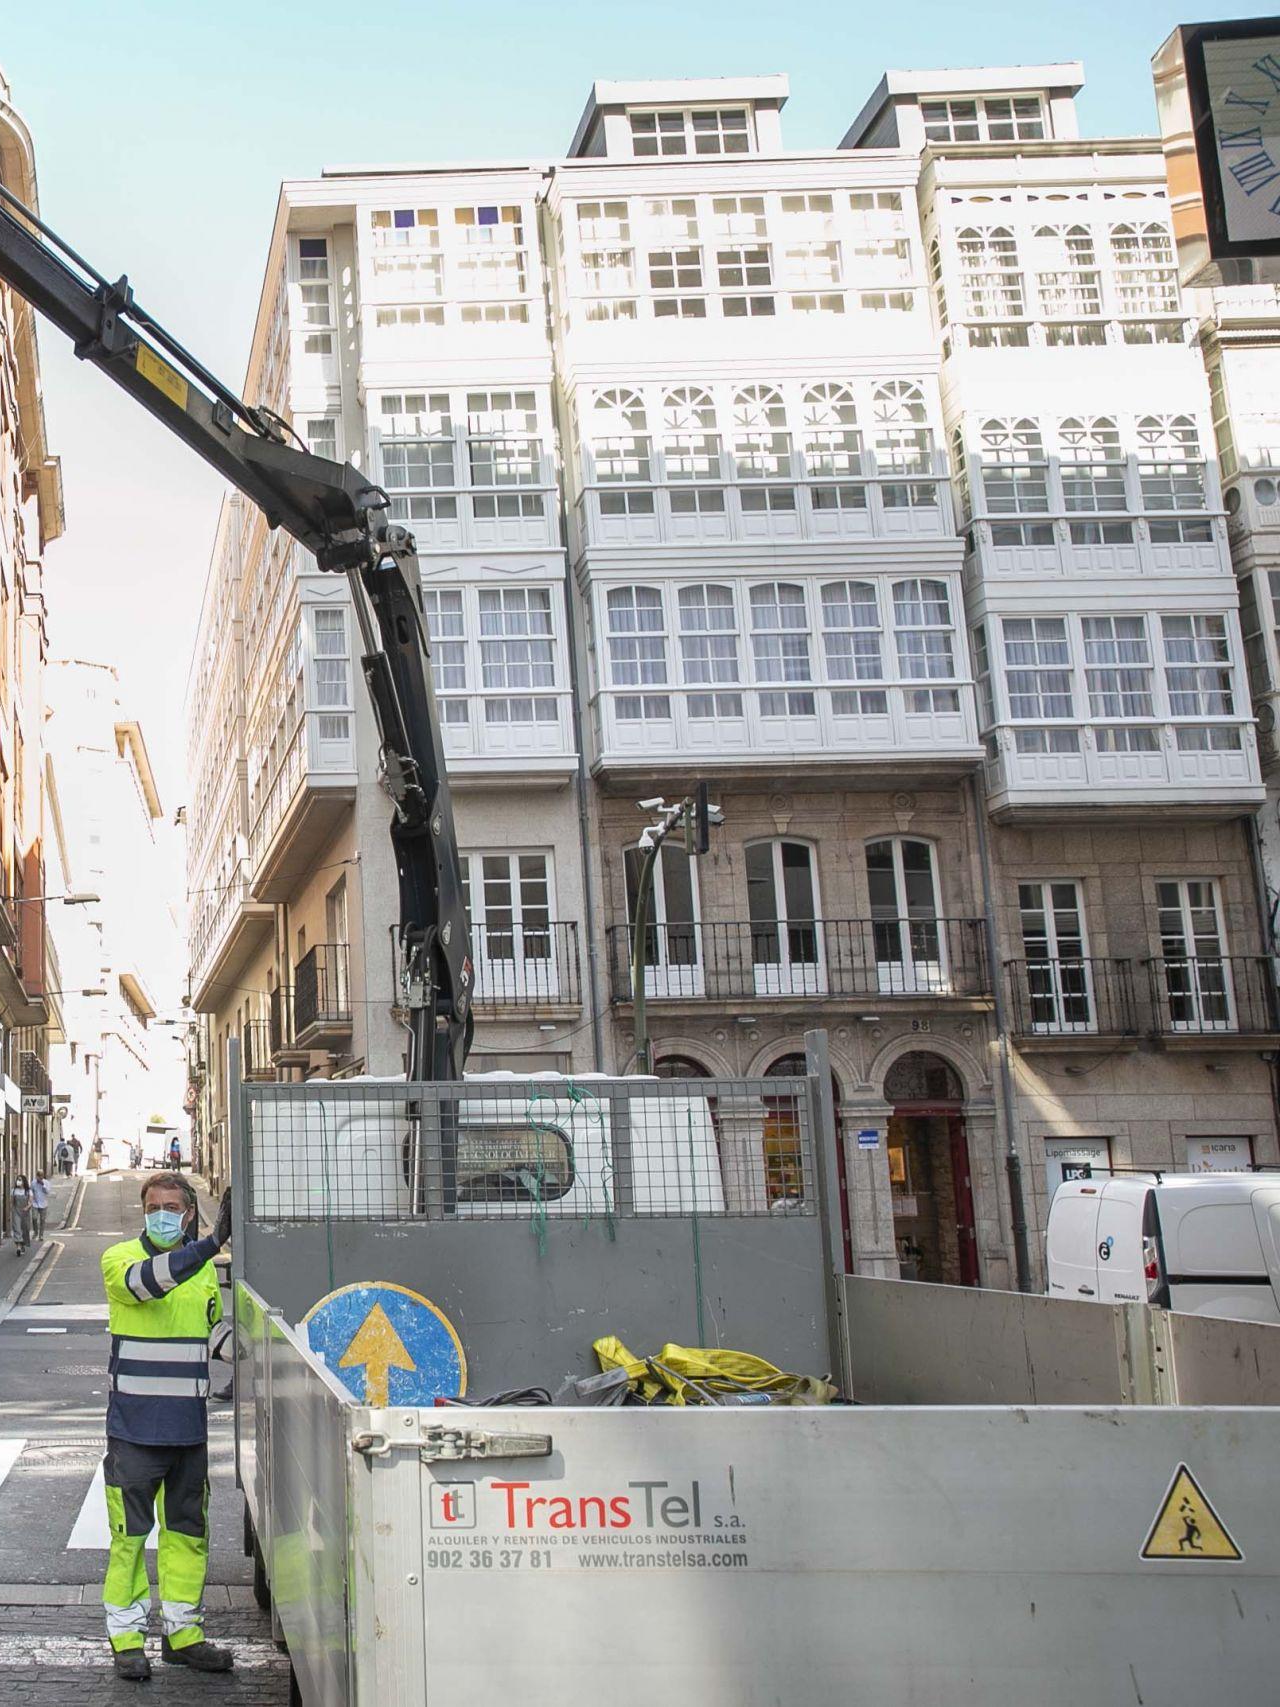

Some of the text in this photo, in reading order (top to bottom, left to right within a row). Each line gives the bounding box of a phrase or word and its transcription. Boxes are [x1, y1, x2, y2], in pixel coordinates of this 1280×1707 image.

[912, 1020, 929, 1031] 98
[490, 1480, 746, 1529] TransTel s.a.
[428, 1534, 747, 1546] ALQUILER Y RENTING DE VEHICULOS INDUSTRIALES
[427, 1548, 748, 1569] 902 36 37 81 www.transtelsa.com
